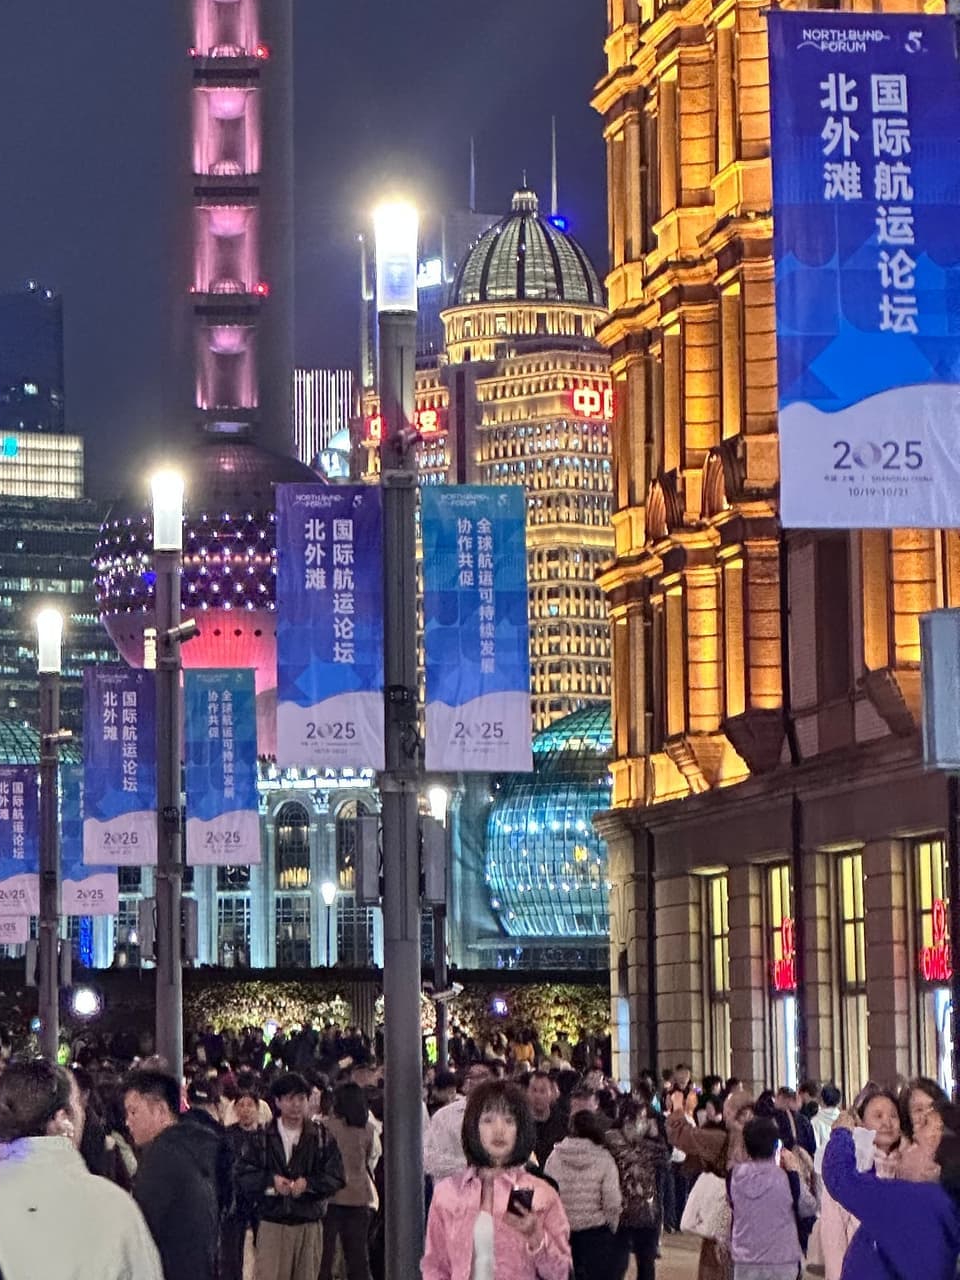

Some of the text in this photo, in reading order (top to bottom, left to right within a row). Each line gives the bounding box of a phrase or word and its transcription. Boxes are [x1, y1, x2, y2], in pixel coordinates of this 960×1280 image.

[820, 40, 867, 53] FORUM
[819, 72, 863, 201] 北外滩
[870, 73, 919, 335] 国际航运论坛
[833, 440, 924, 470] 2025
[304, 518, 327, 590] 北外滩
[333, 518, 355, 664] 国际航运论坛
[103, 690, 118, 741] 北外滩
[306, 722, 356, 739] 2025
[454, 721, 504, 739] 2025
[122, 690, 138, 793] 国际航运论坛
[103, 831, 138, 845] 2025
[206, 830, 241, 844] 2025
